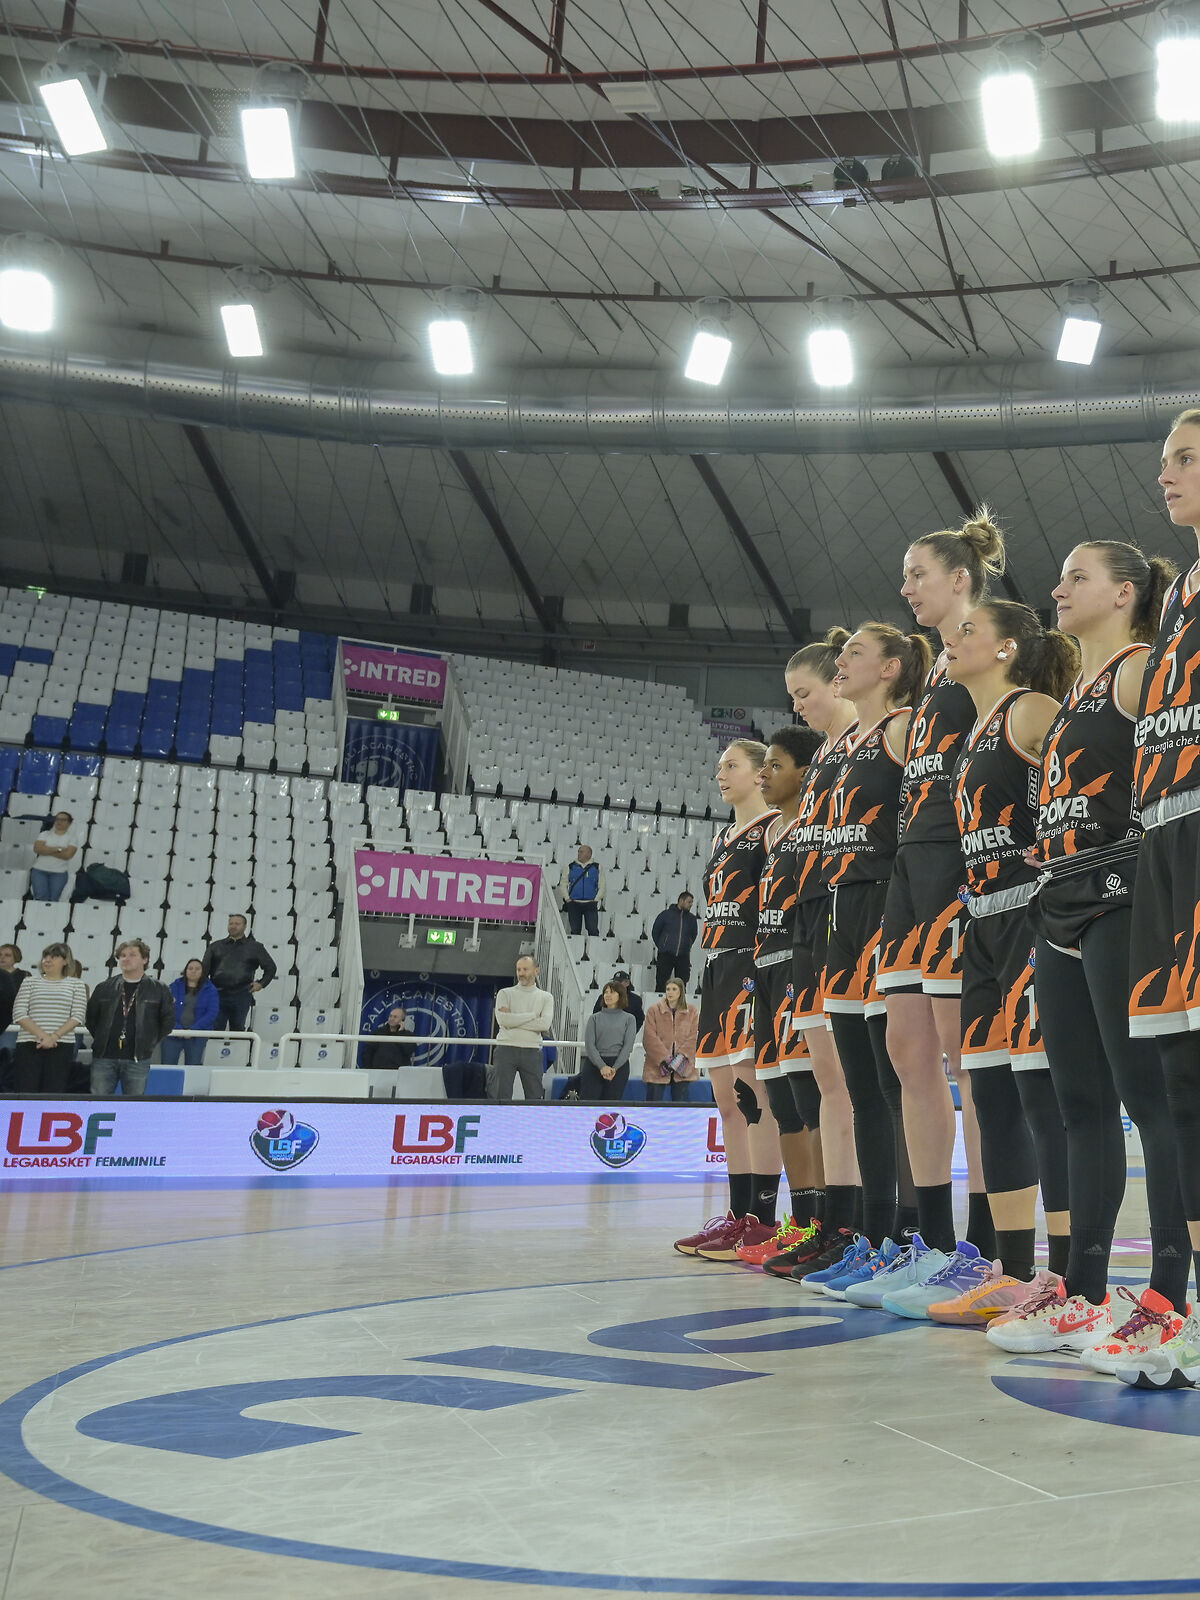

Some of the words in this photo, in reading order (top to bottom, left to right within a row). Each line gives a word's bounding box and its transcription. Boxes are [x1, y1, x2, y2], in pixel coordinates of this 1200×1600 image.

[359, 660, 441, 688] INTRED
[1165, 651, 1178, 695] 7
[1077, 699, 1108, 713] EA7
[911, 717, 927, 750] 12
[1175, 736, 1193, 747] che
[976, 736, 1001, 753] EA7
[825, 753, 846, 764] EA7
[856, 749, 881, 760] EA7
[1047, 750, 1062, 787] 8
[800, 790, 815, 820] 23
[832, 787, 845, 818] 17
[957, 786, 975, 822] 11
[736, 841, 760, 851] EA7
[781, 843, 797, 852] EA7
[388, 867, 533, 907] INTRED
[1102, 887, 1129, 899] BITRE
[362, 990, 467, 1038] PALLACANESTRO
[6, 1111, 117, 1155] LBF
[392, 1114, 481, 1154] LBF
[269, 1139, 302, 1154] LBF
[606, 1139, 633, 1153] LBF
[3, 1157, 91, 1168] LEGABASKET
[95, 1156, 166, 1168] FEMMINILE
[391, 1155, 461, 1165] LEGABASKET
[464, 1154, 523, 1164] FEMMINILE
